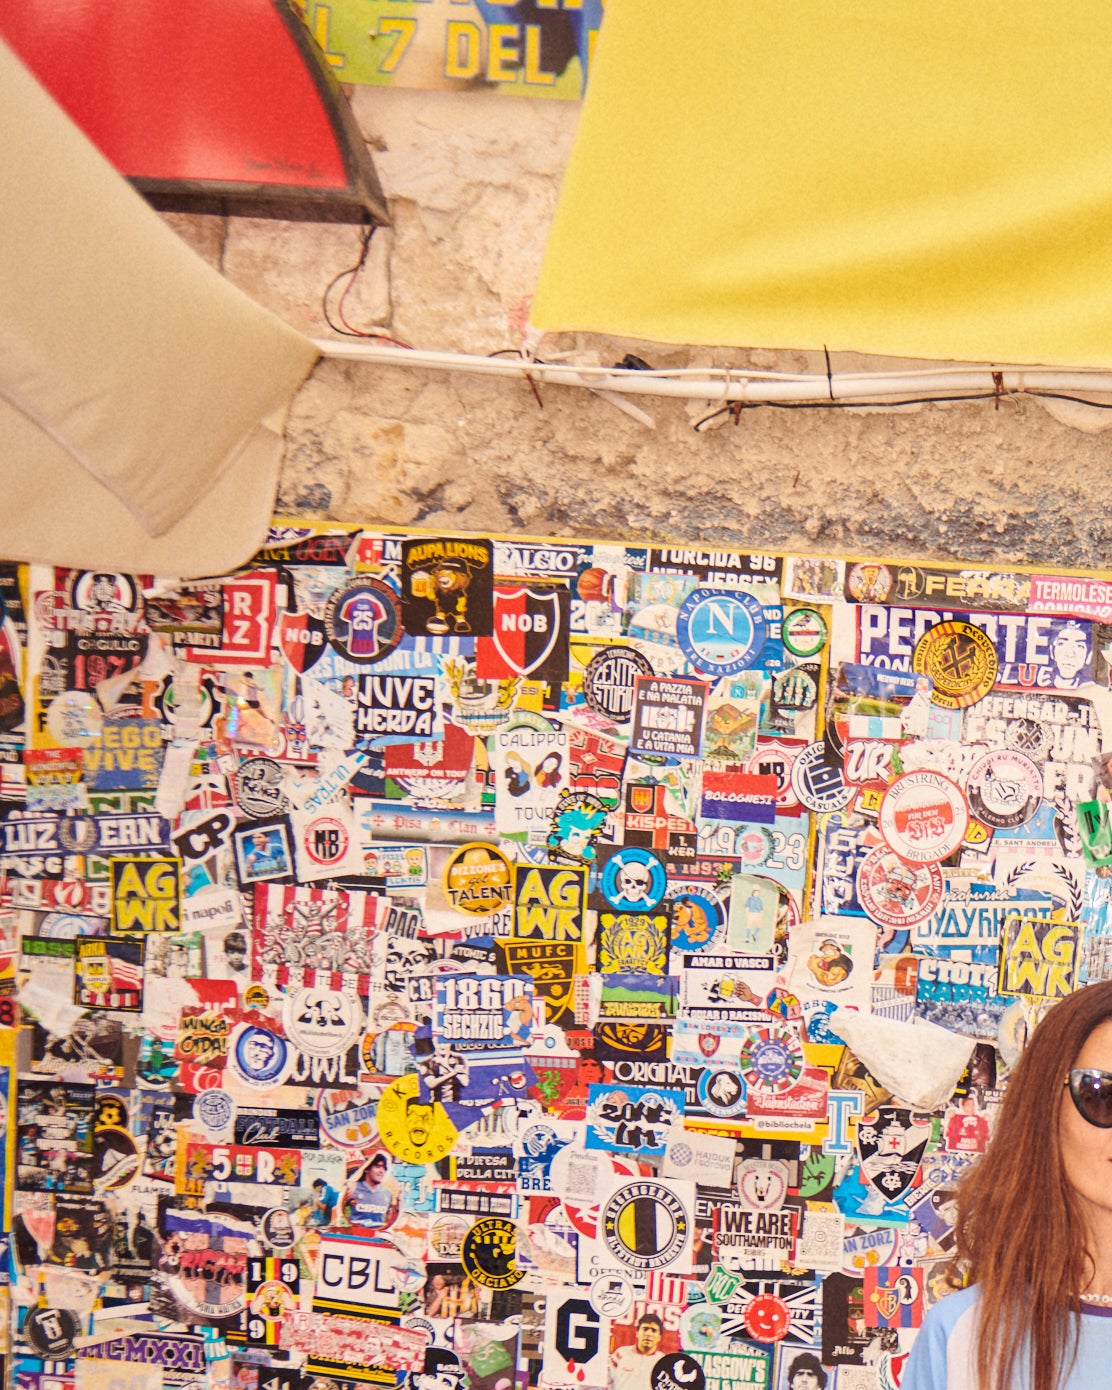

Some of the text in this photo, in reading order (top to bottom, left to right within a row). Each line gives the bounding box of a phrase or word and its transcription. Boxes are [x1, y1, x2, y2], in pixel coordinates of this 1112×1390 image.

[378, 16, 557, 86] 7 DEL
[501, 614, 548, 632] NOB
[706, 603, 736, 635] N
[358, 676, 434, 710] JUVE
[705, 791, 774, 804] BOLOGNESI
[889, 773, 949, 799] BRUSTRING
[4, 817, 161, 852] LUZ ERN
[669, 847, 695, 857] KER
[906, 844, 950, 863] BRIGADE
[116, 863, 173, 897] AG
[520, 869, 584, 904] AG
[449, 886, 513, 902] TALENT
[115, 898, 179, 931] WK
[197, 901, 235, 919] napoli
[516, 904, 583, 941] WK
[516, 945, 567, 959] MUFC
[1012, 923, 1072, 960] AG
[734, 958, 769, 968] VASCO
[442, 1014, 504, 1040] SECHZIG
[614, 1061, 698, 1085] ORIGINAL
[725, 1212, 789, 1235] WE ARE
[716, 1234, 793, 1249] SOUTHAMPTON
[322, 1253, 395, 1293] CBL
[556, 1301, 600, 1364] G
